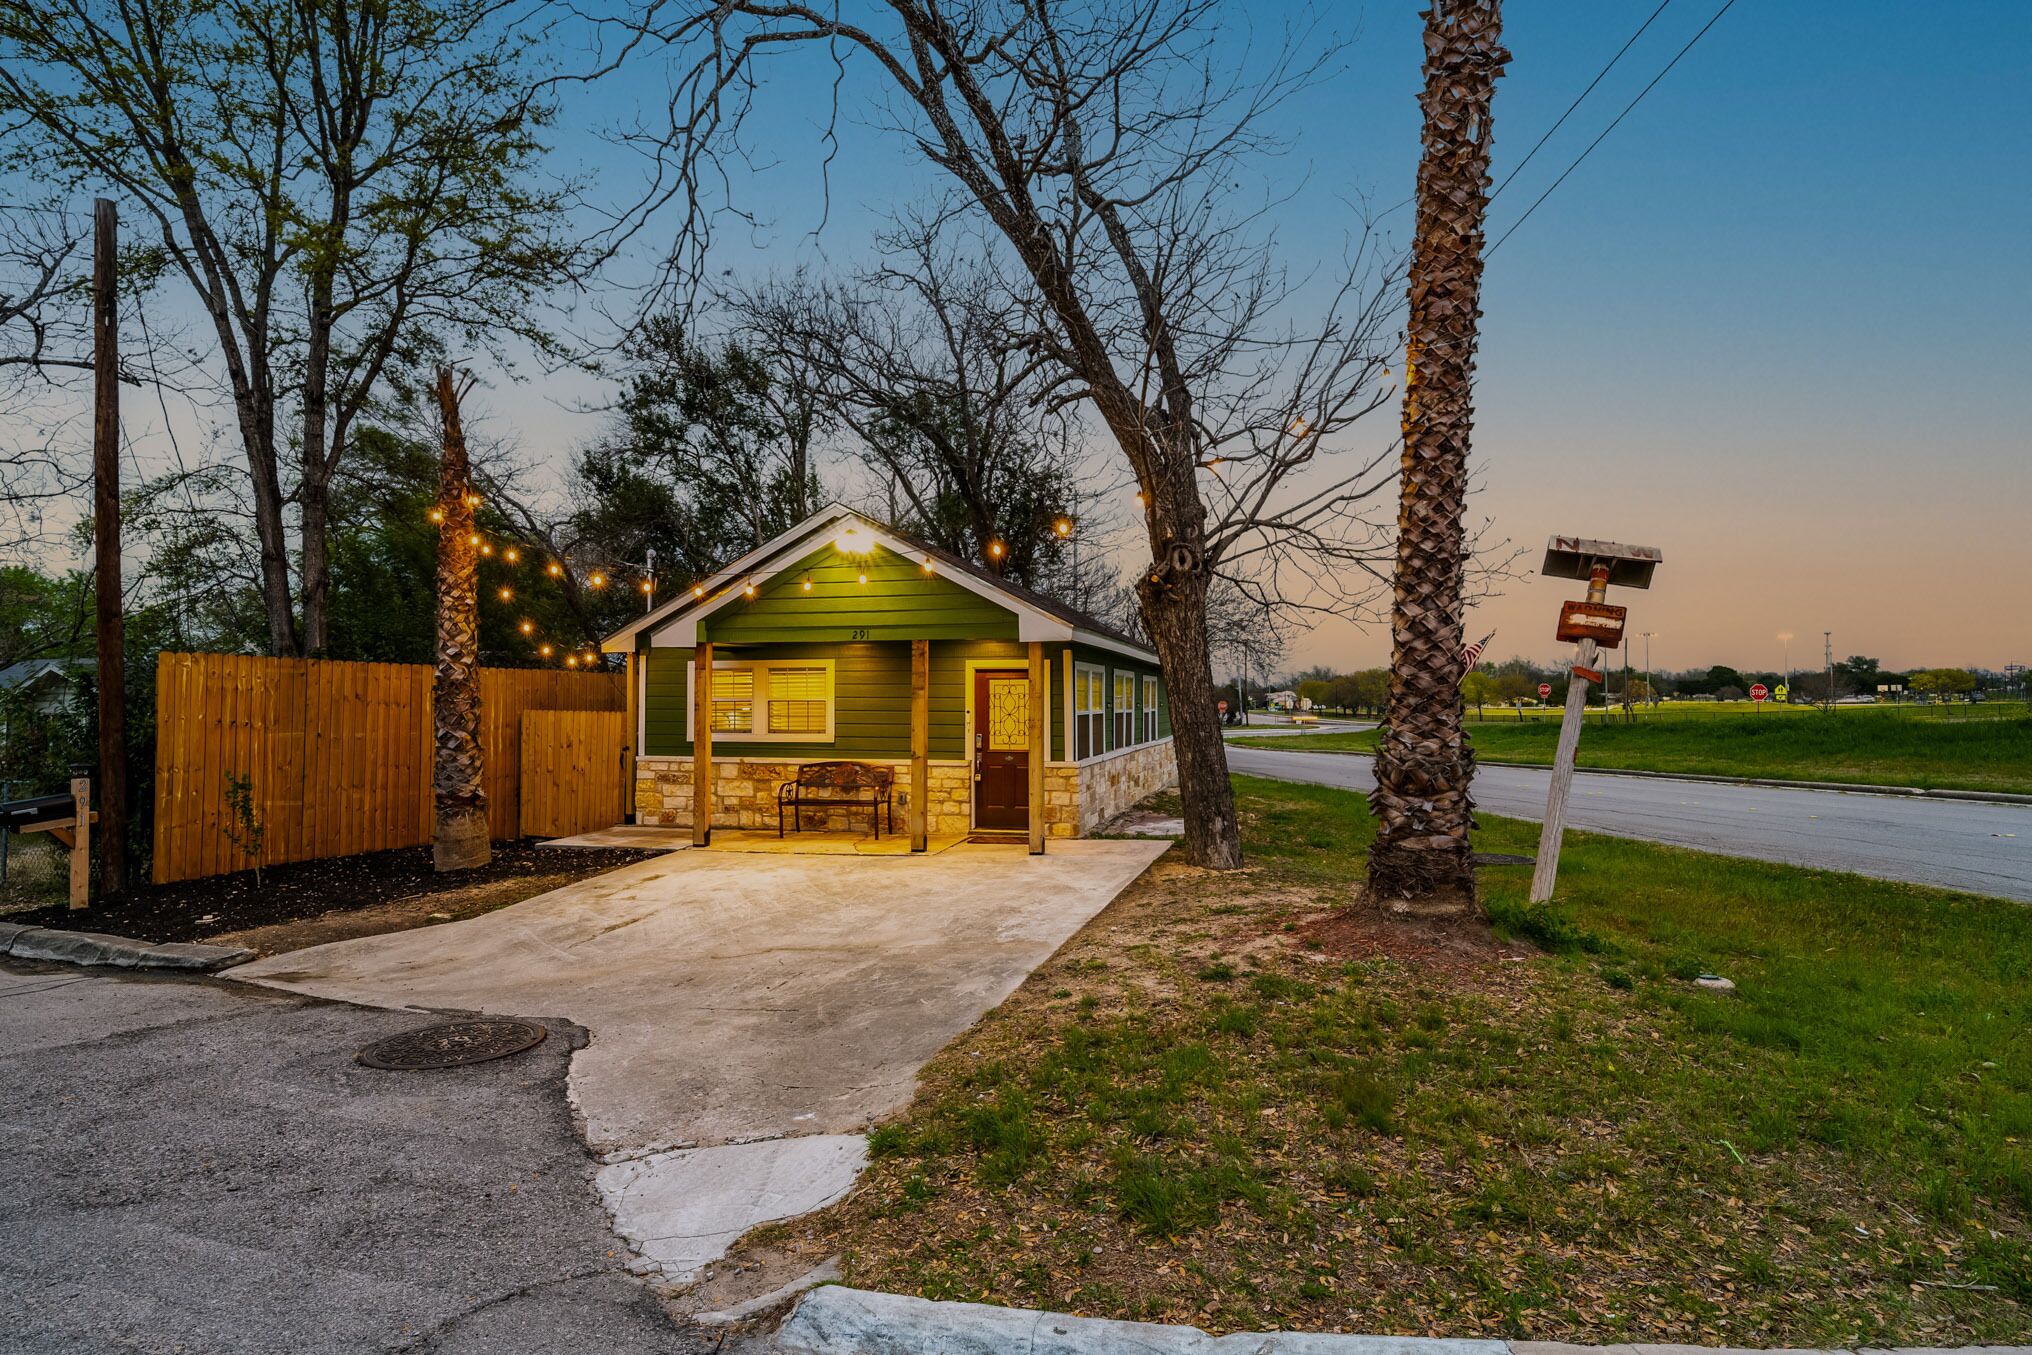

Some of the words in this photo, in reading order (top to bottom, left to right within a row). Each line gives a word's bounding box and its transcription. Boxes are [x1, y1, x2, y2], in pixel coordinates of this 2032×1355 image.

[852, 630, 870, 640] 291
[1751, 688, 1767, 696] STOP
[79, 778, 88, 827] 291
